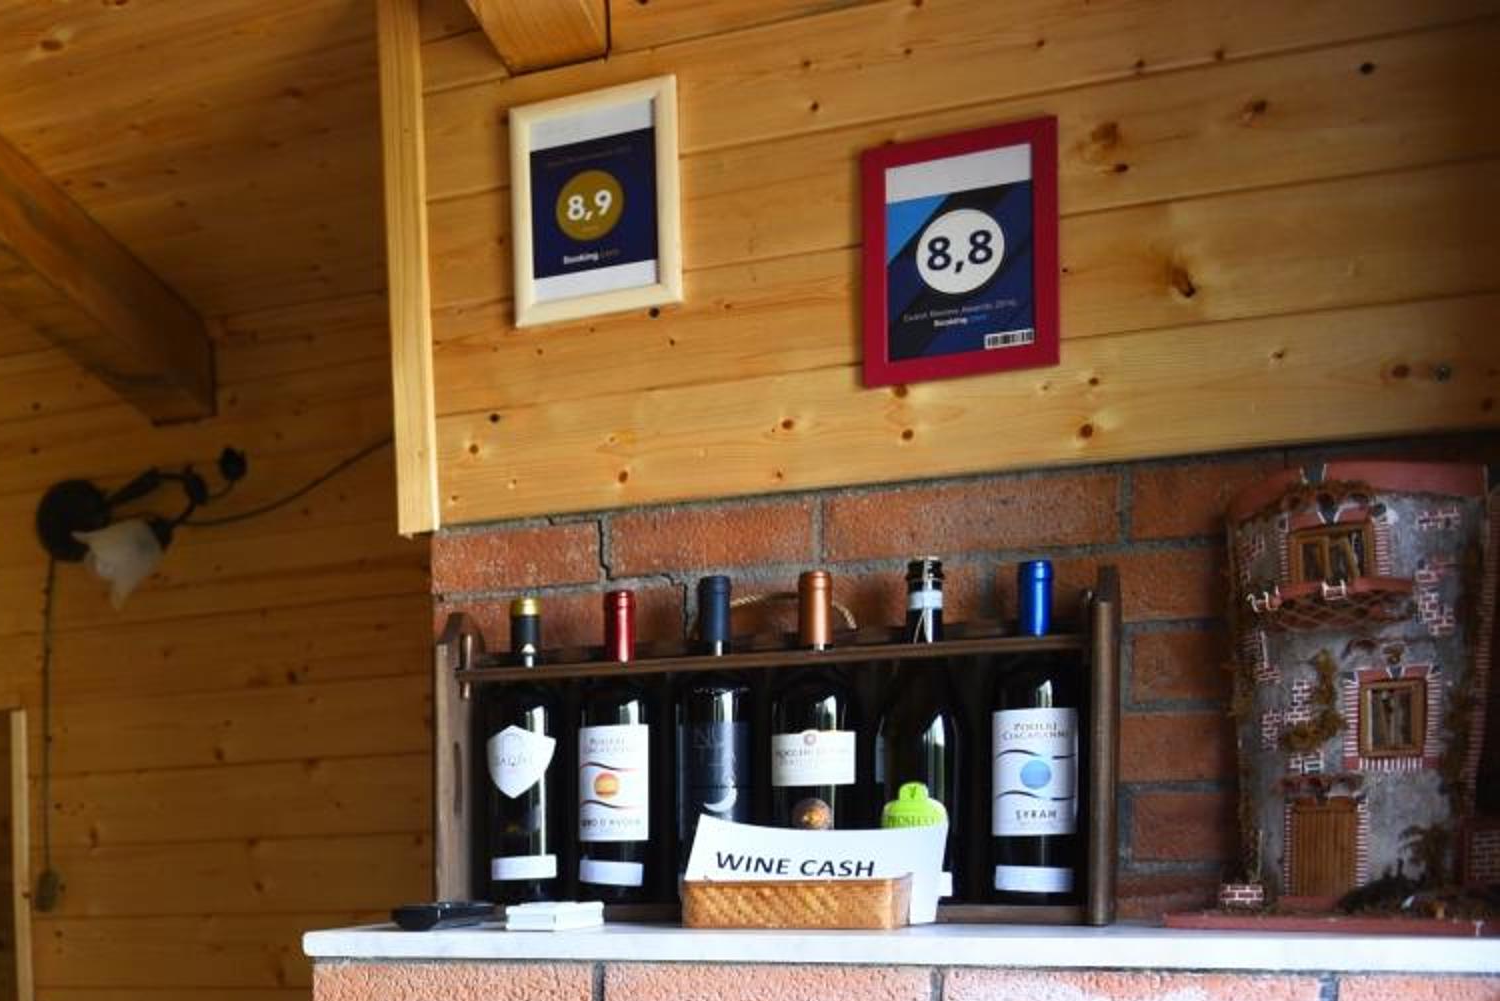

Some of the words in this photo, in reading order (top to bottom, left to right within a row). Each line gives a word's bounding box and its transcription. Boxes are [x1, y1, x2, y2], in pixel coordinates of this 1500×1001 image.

[567, 189, 612, 221] 8,9
[927, 229, 993, 274] 8,8
[716, 851, 790, 875] WINE
[799, 859, 875, 877] CASH
